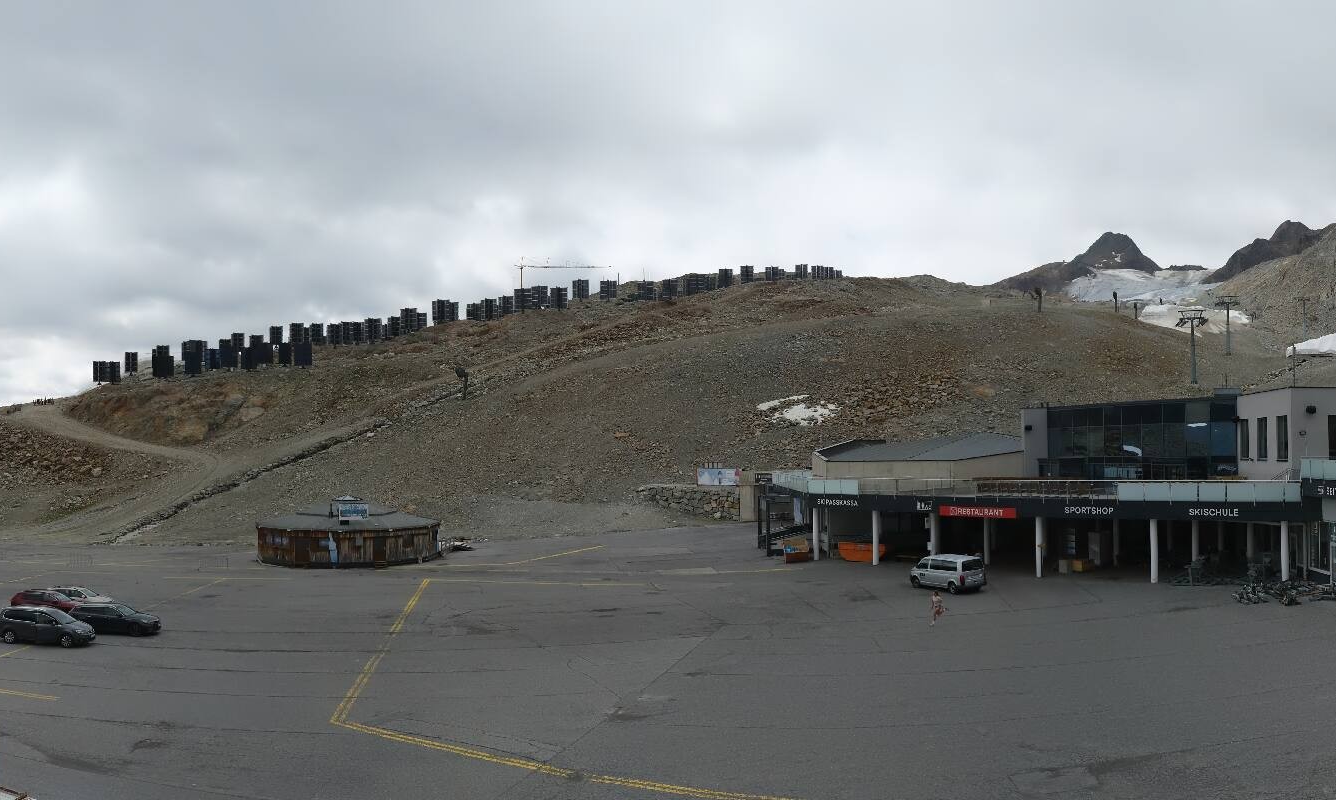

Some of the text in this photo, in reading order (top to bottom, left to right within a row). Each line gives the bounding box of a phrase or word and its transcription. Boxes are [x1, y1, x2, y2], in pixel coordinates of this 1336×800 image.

[957, 507, 1004, 517] RESTAURANT
[1064, 506, 1114, 515] SPORTSHOP
[1189, 508, 1239, 517] SKISCHULE
